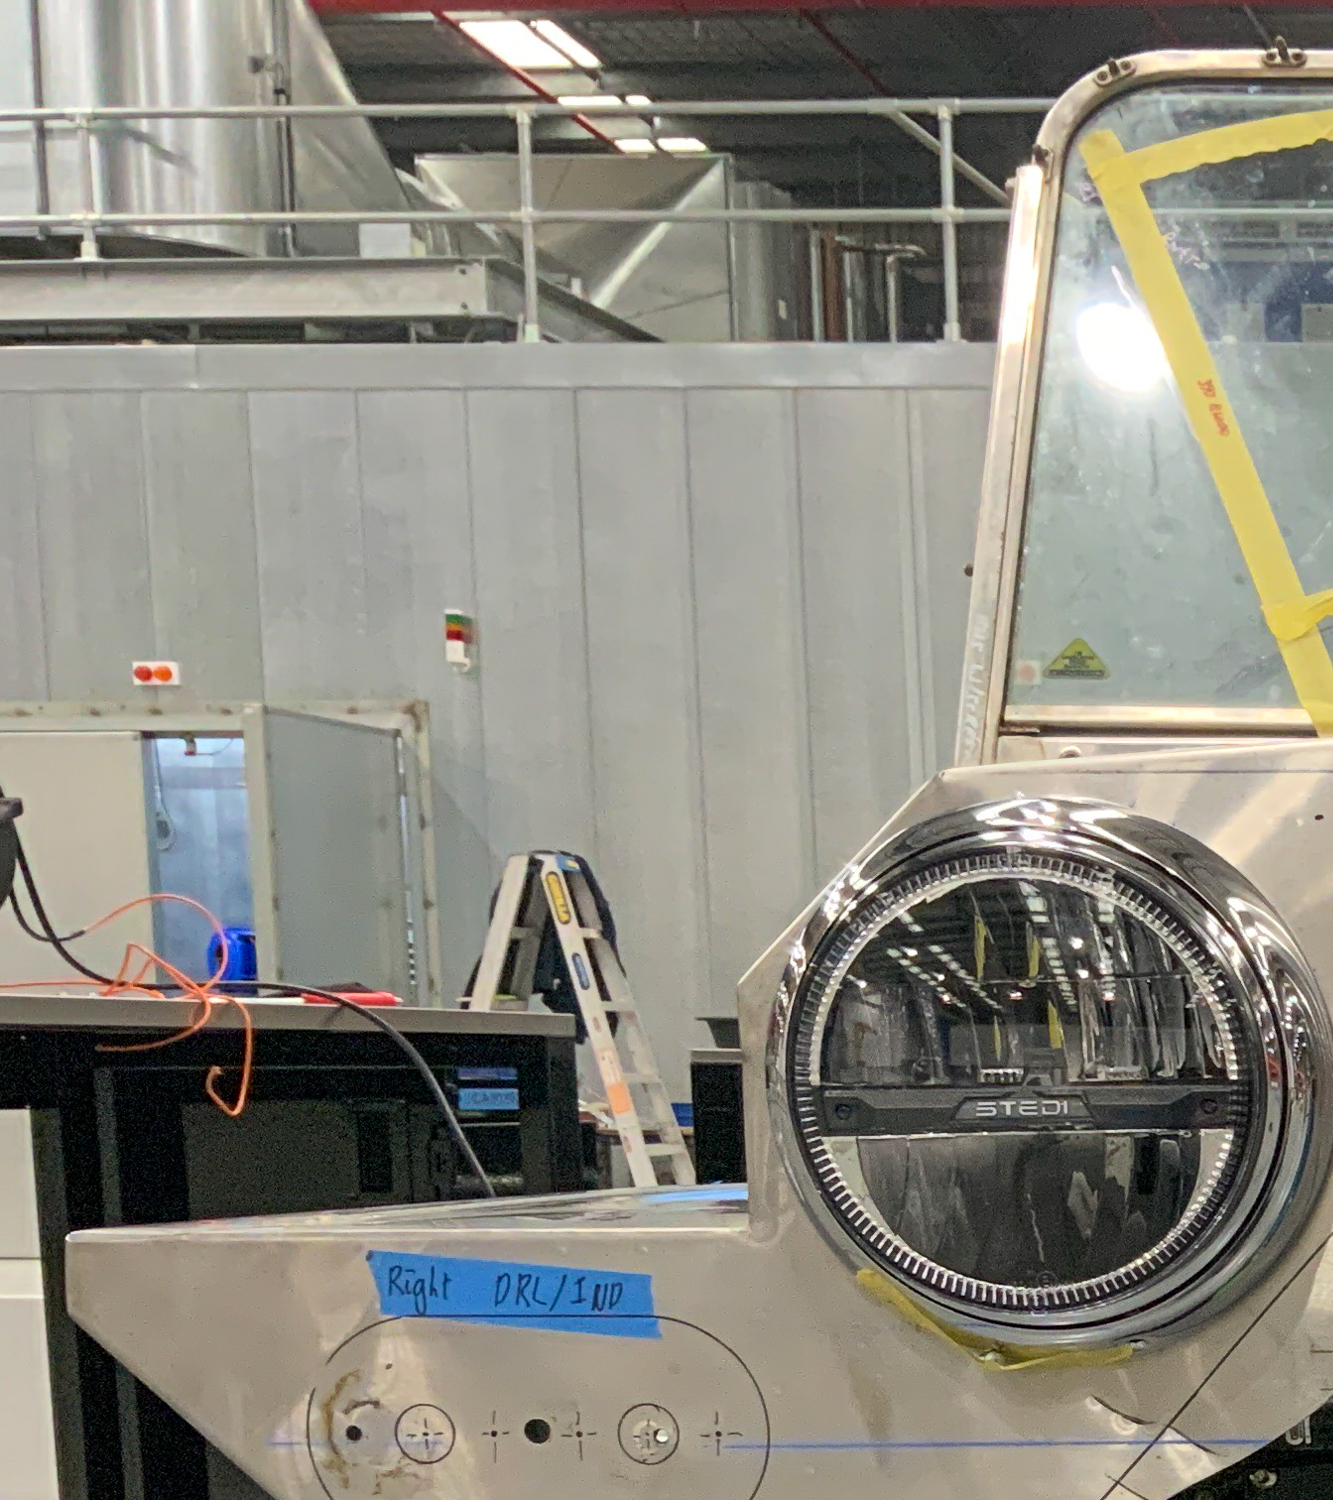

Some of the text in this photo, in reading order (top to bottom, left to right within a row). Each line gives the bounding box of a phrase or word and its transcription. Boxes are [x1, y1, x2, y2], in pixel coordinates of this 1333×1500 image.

[975, 1100, 1069, 1117] STEDI
[388, 1265, 624, 1316] Right DRL/IND
